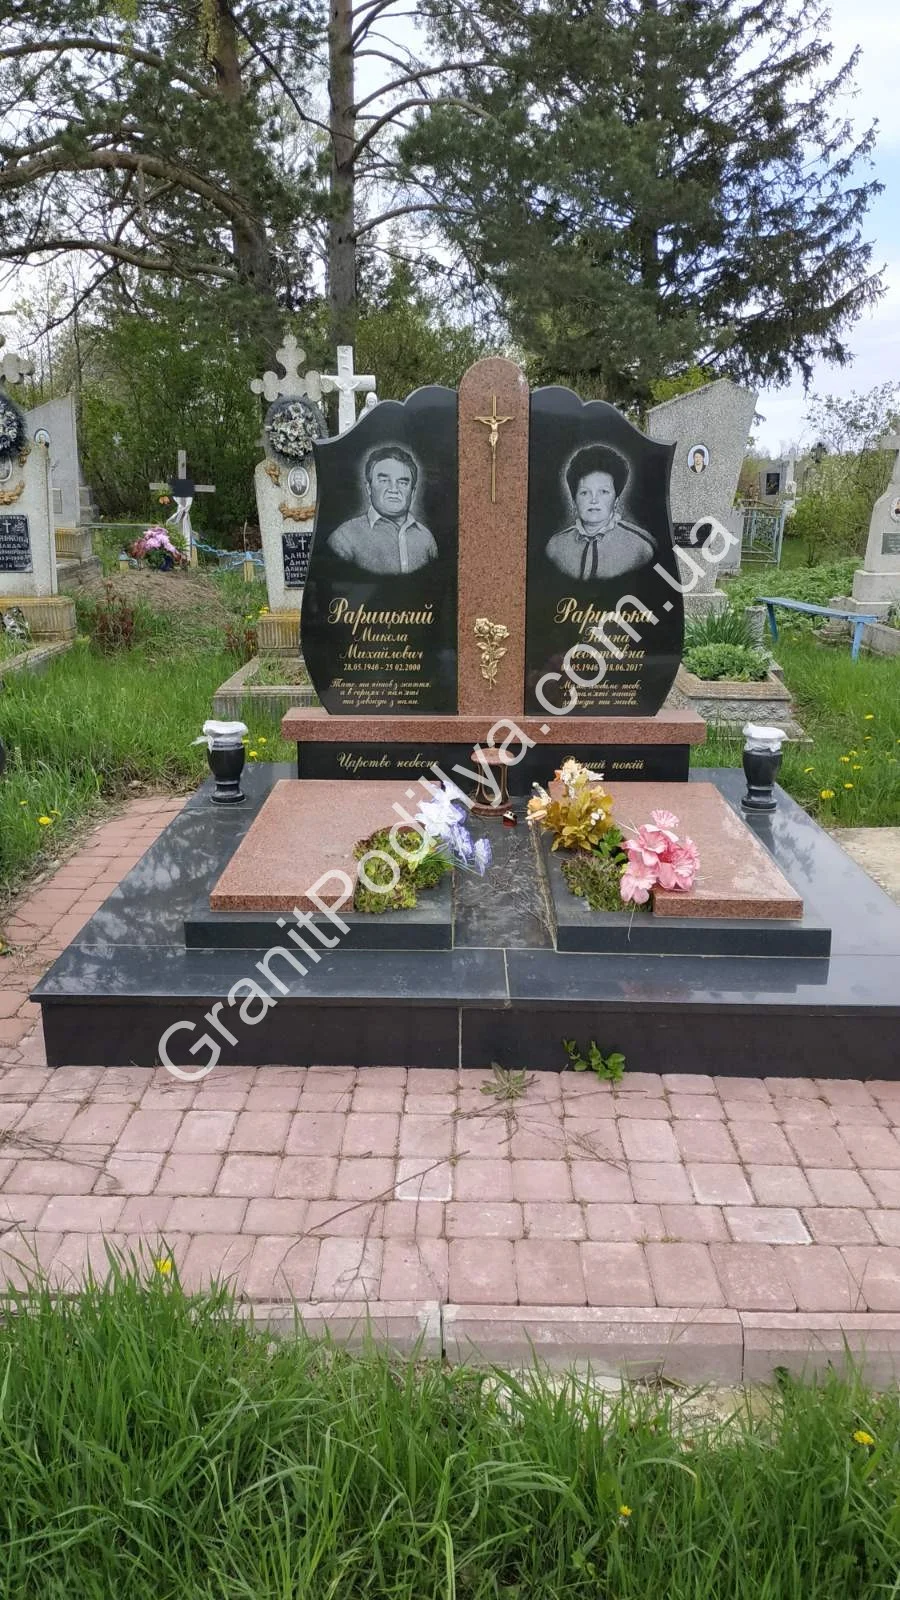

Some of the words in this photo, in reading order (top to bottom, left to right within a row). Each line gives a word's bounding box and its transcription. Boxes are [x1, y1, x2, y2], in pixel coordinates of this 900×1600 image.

[328, 597, 434, 635] Рарицький
[354, 626, 409, 642] Микола
[339, 643, 424, 659] Михайлович
[337, 752, 391, 773] Царство
[612, 759, 644, 770] покій
